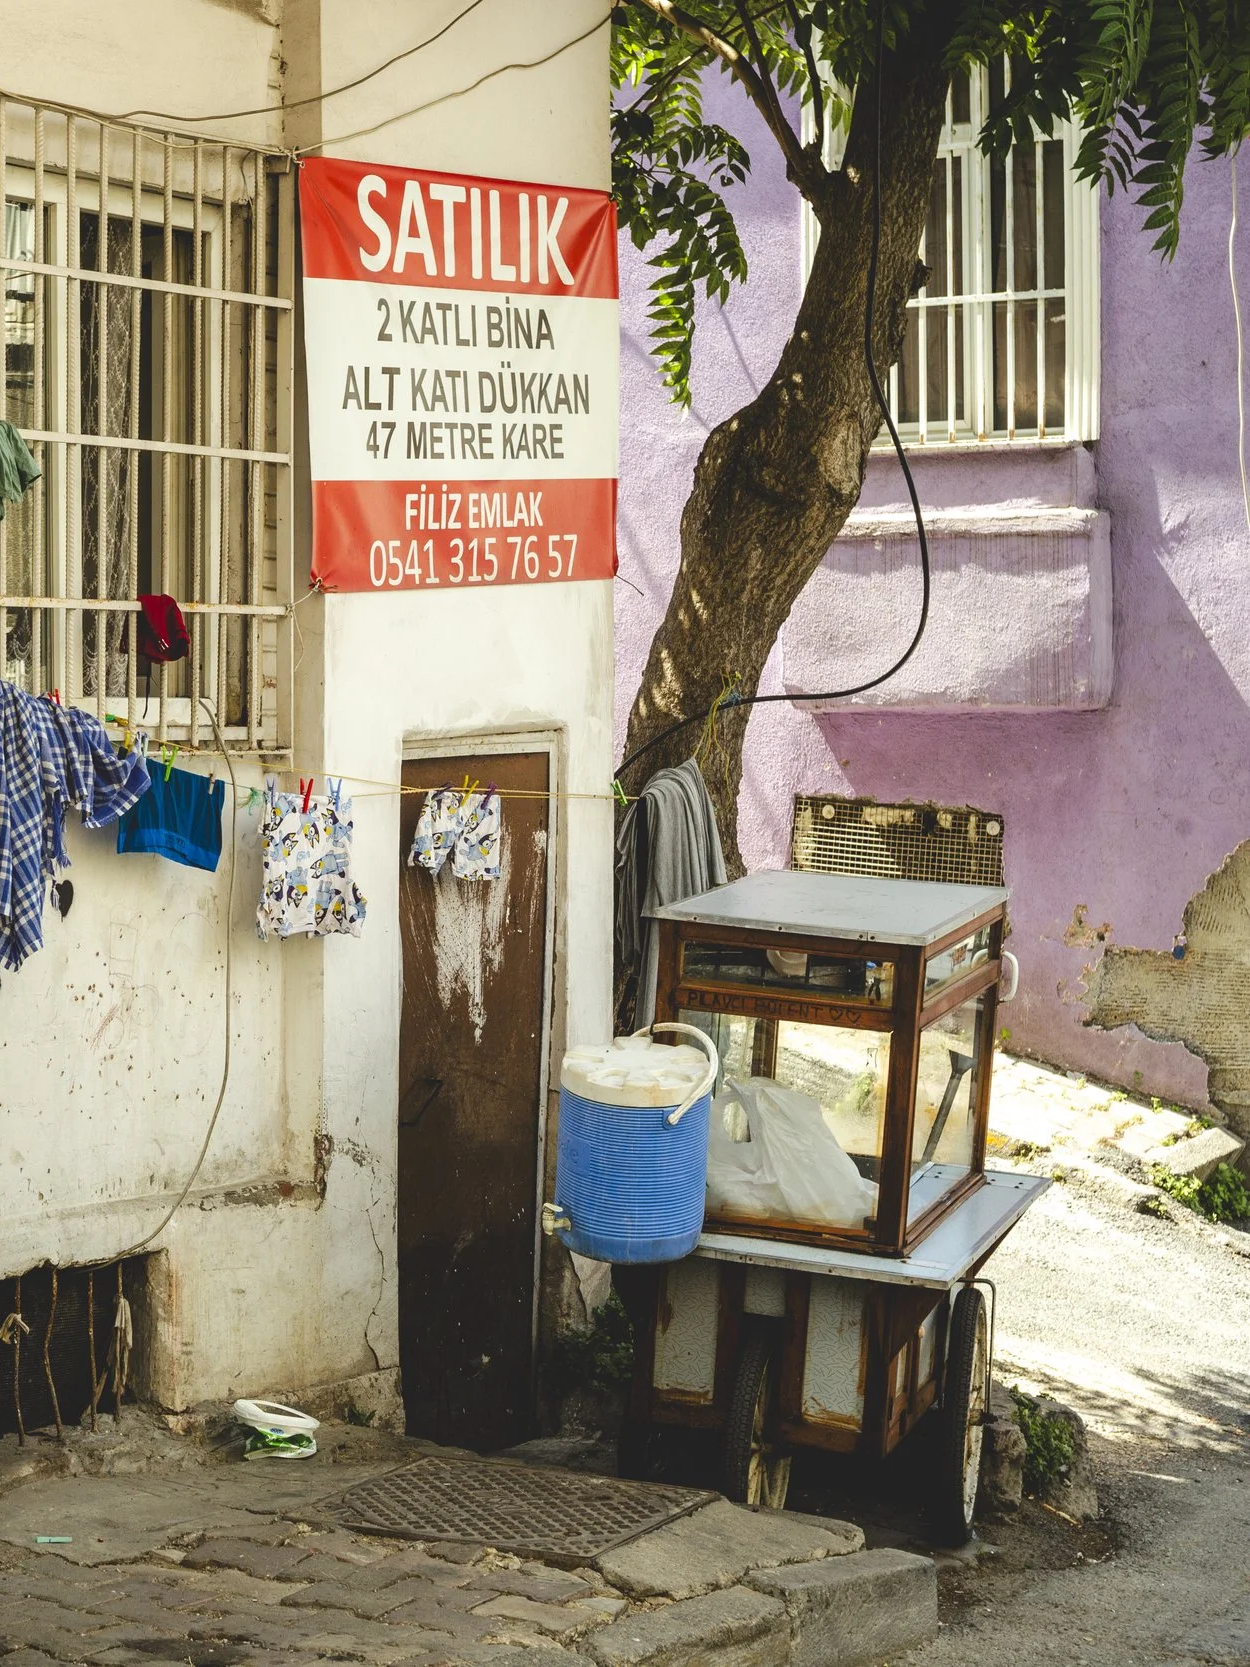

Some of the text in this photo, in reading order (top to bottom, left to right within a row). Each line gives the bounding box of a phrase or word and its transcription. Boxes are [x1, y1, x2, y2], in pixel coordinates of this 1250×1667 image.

[357, 174, 576, 286] SATILIK
[377, 296, 555, 350] 2 KATLI BİNA
[342, 361, 590, 415] ALT KATI DÜKKAN
[366, 421, 565, 460] 47 METRE KARE
[405, 484, 544, 530] FİLİZ EMLAK
[369, 534, 578, 587] 0541 315 76 57
